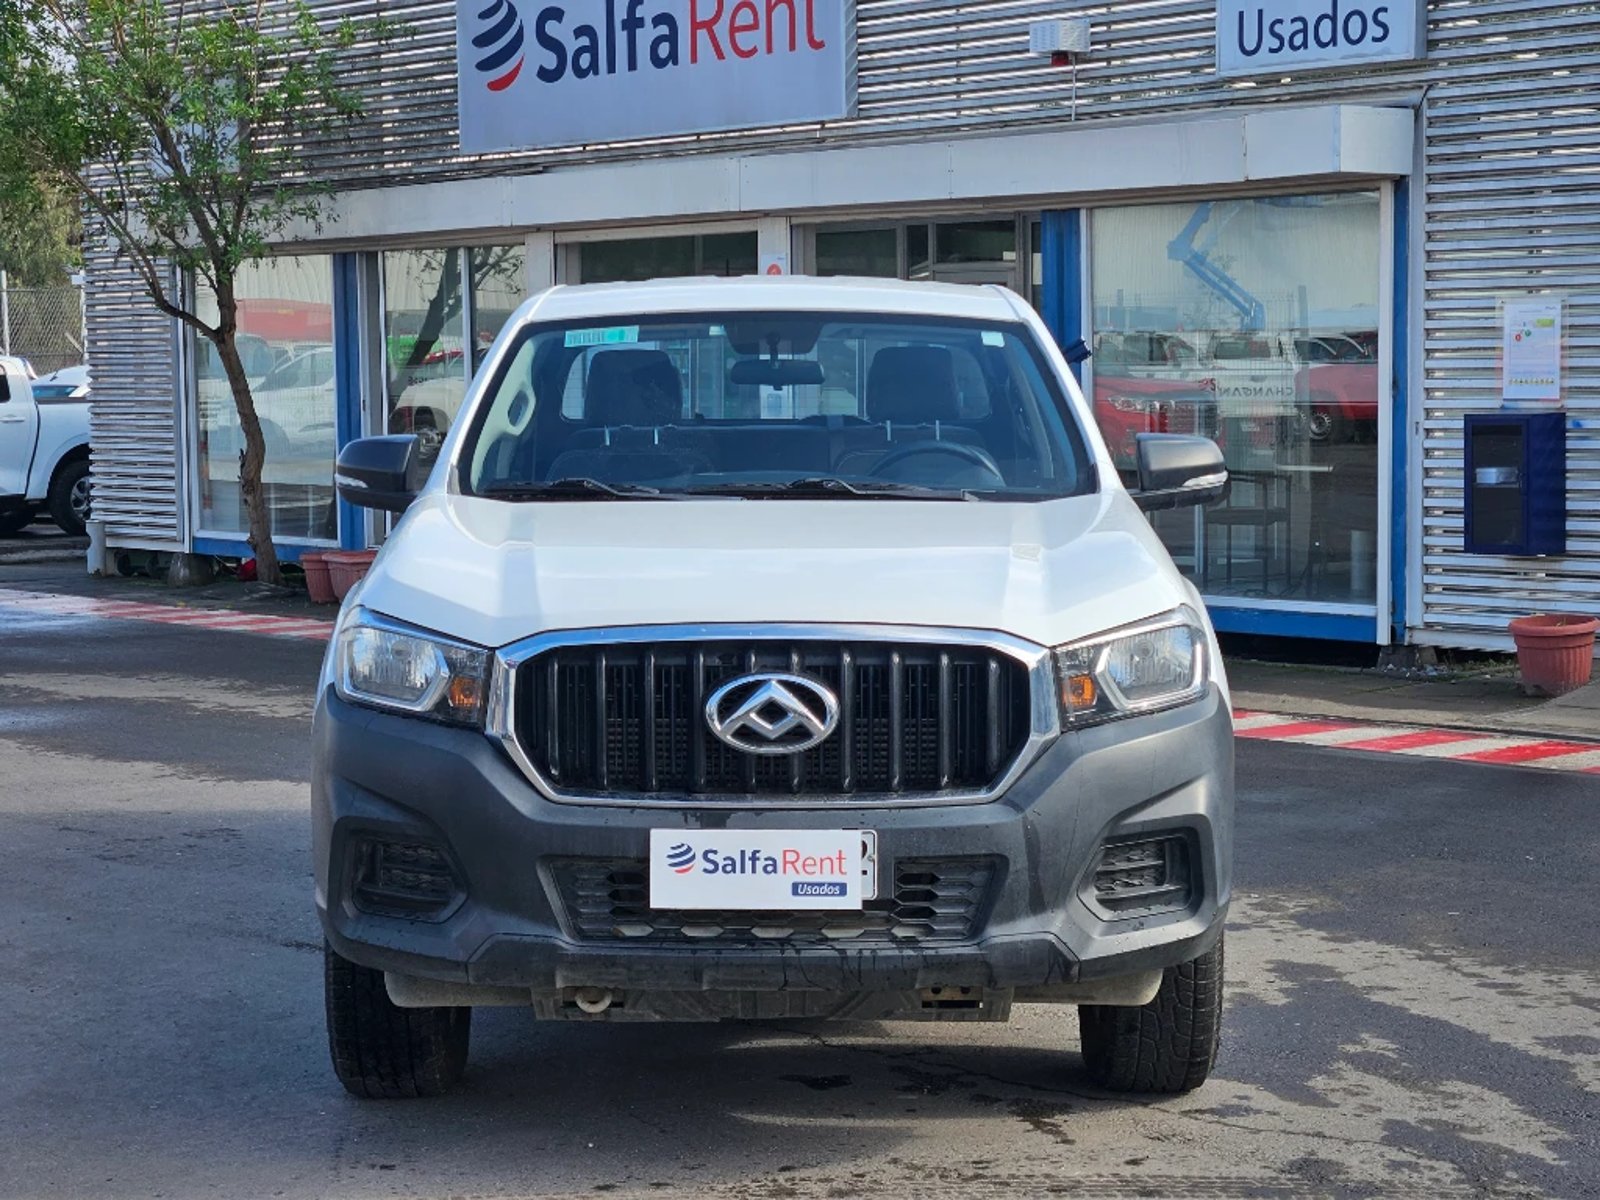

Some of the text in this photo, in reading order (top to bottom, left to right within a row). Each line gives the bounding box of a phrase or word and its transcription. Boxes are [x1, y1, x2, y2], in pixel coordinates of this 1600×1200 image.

[535, 0, 826, 84] SalfaRent
[1238, 0, 1390, 57] Usados
[701, 848, 848, 875] SalfaRent
[797, 883, 841, 895] Usados
